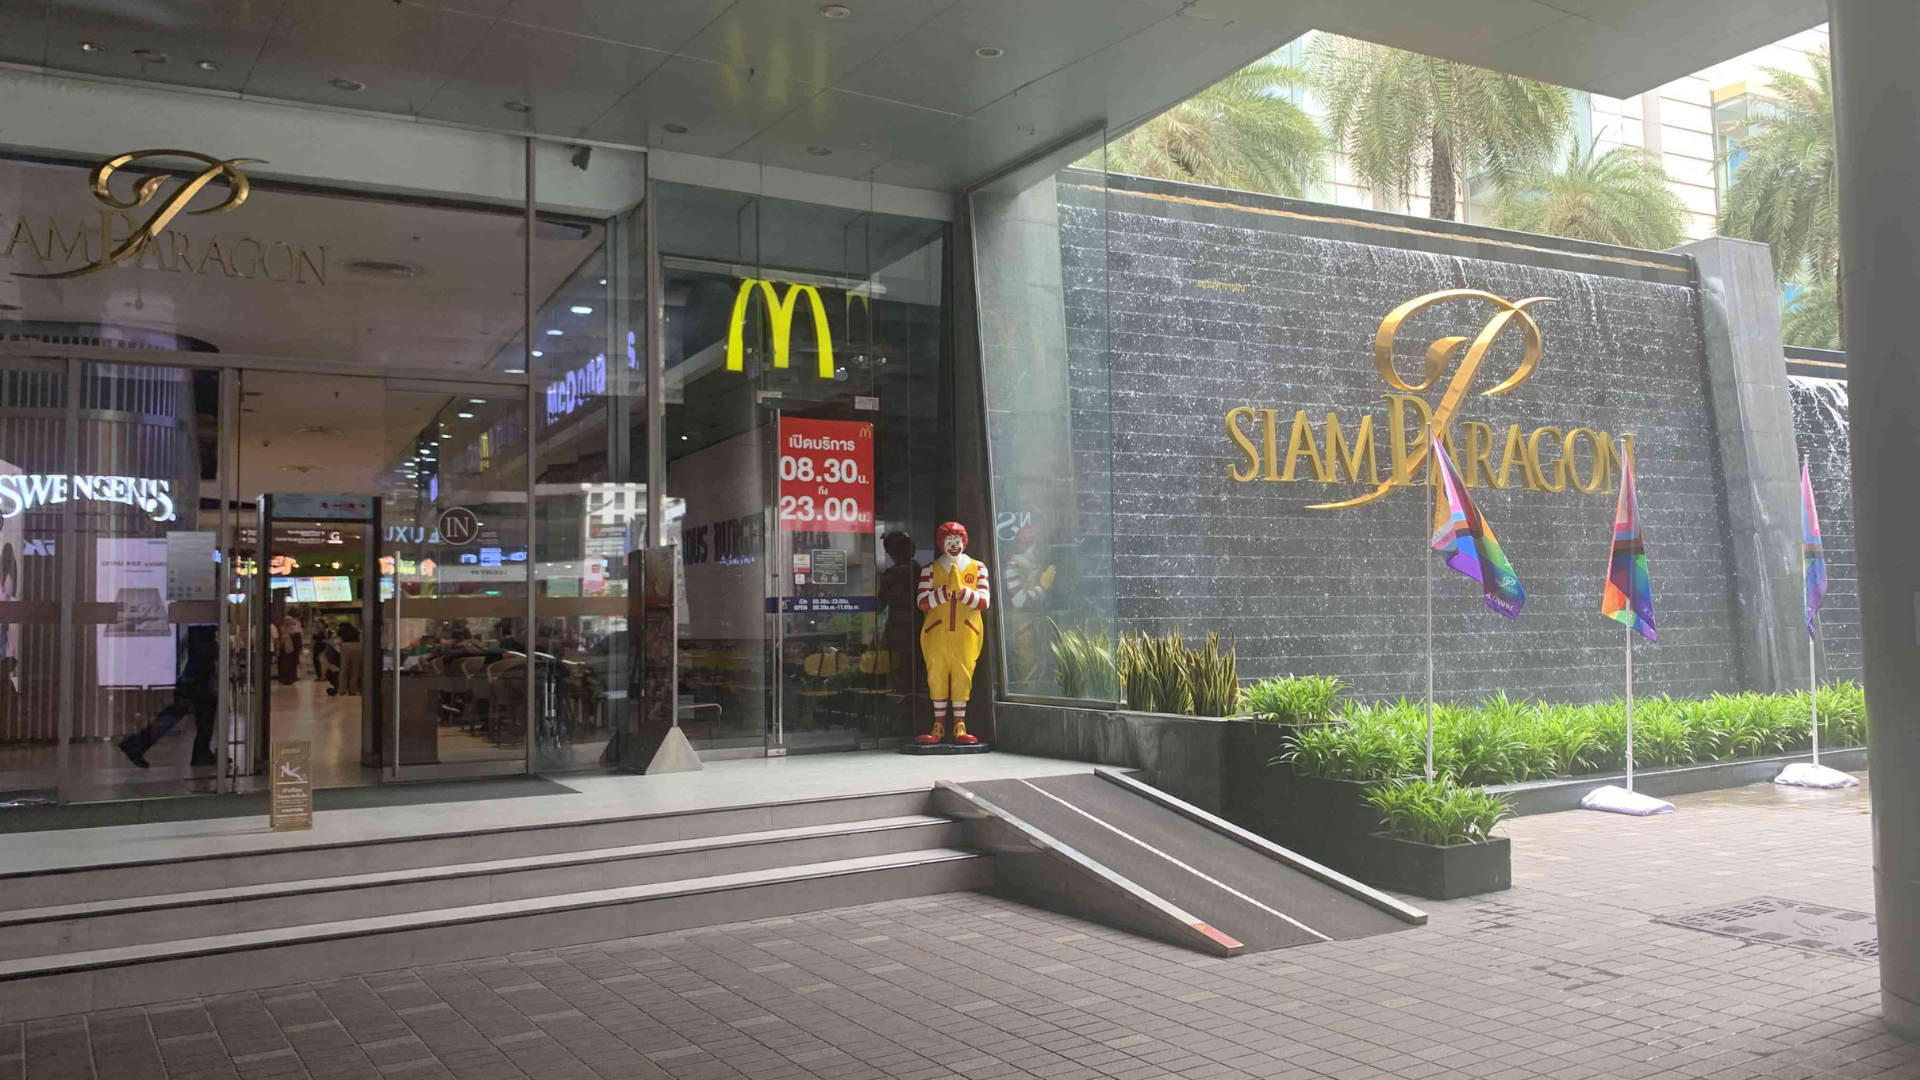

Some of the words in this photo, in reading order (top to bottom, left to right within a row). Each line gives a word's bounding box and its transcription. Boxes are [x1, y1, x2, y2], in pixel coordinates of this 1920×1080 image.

[95, 208, 330, 285] PARAGON
[788, 434, 856, 452] เปิดบริการ
[1224, 406, 1380, 487] SIAM
[1380, 394, 1637, 495] PARAGON
[445, 516, 470, 538] IN
